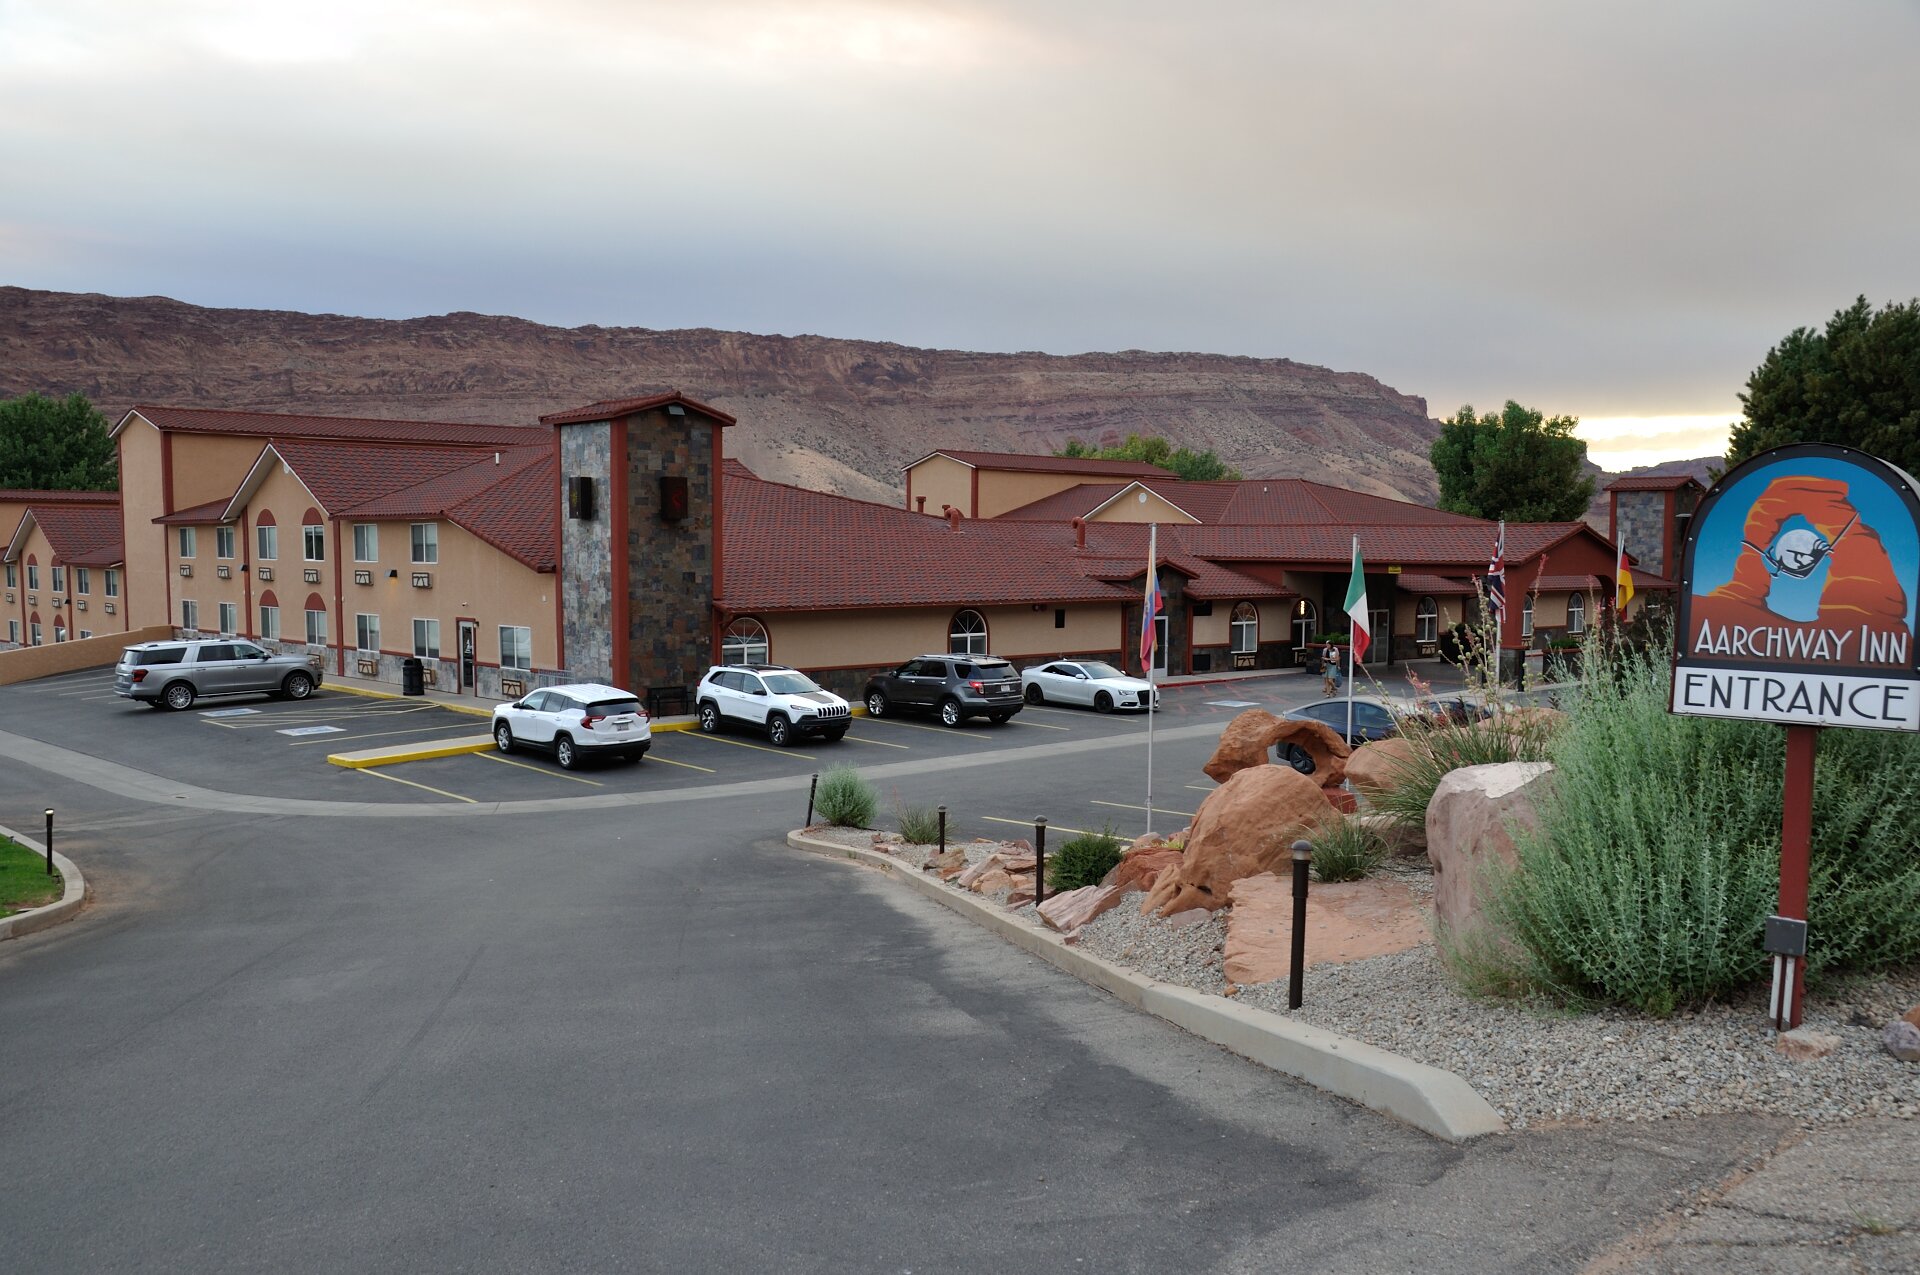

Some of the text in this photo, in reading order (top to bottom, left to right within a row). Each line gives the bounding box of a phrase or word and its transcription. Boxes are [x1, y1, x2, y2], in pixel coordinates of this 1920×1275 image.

[1694, 618, 1908, 664] AARCHWAY INN
[1683, 673, 1909, 722] ENTRANCE
